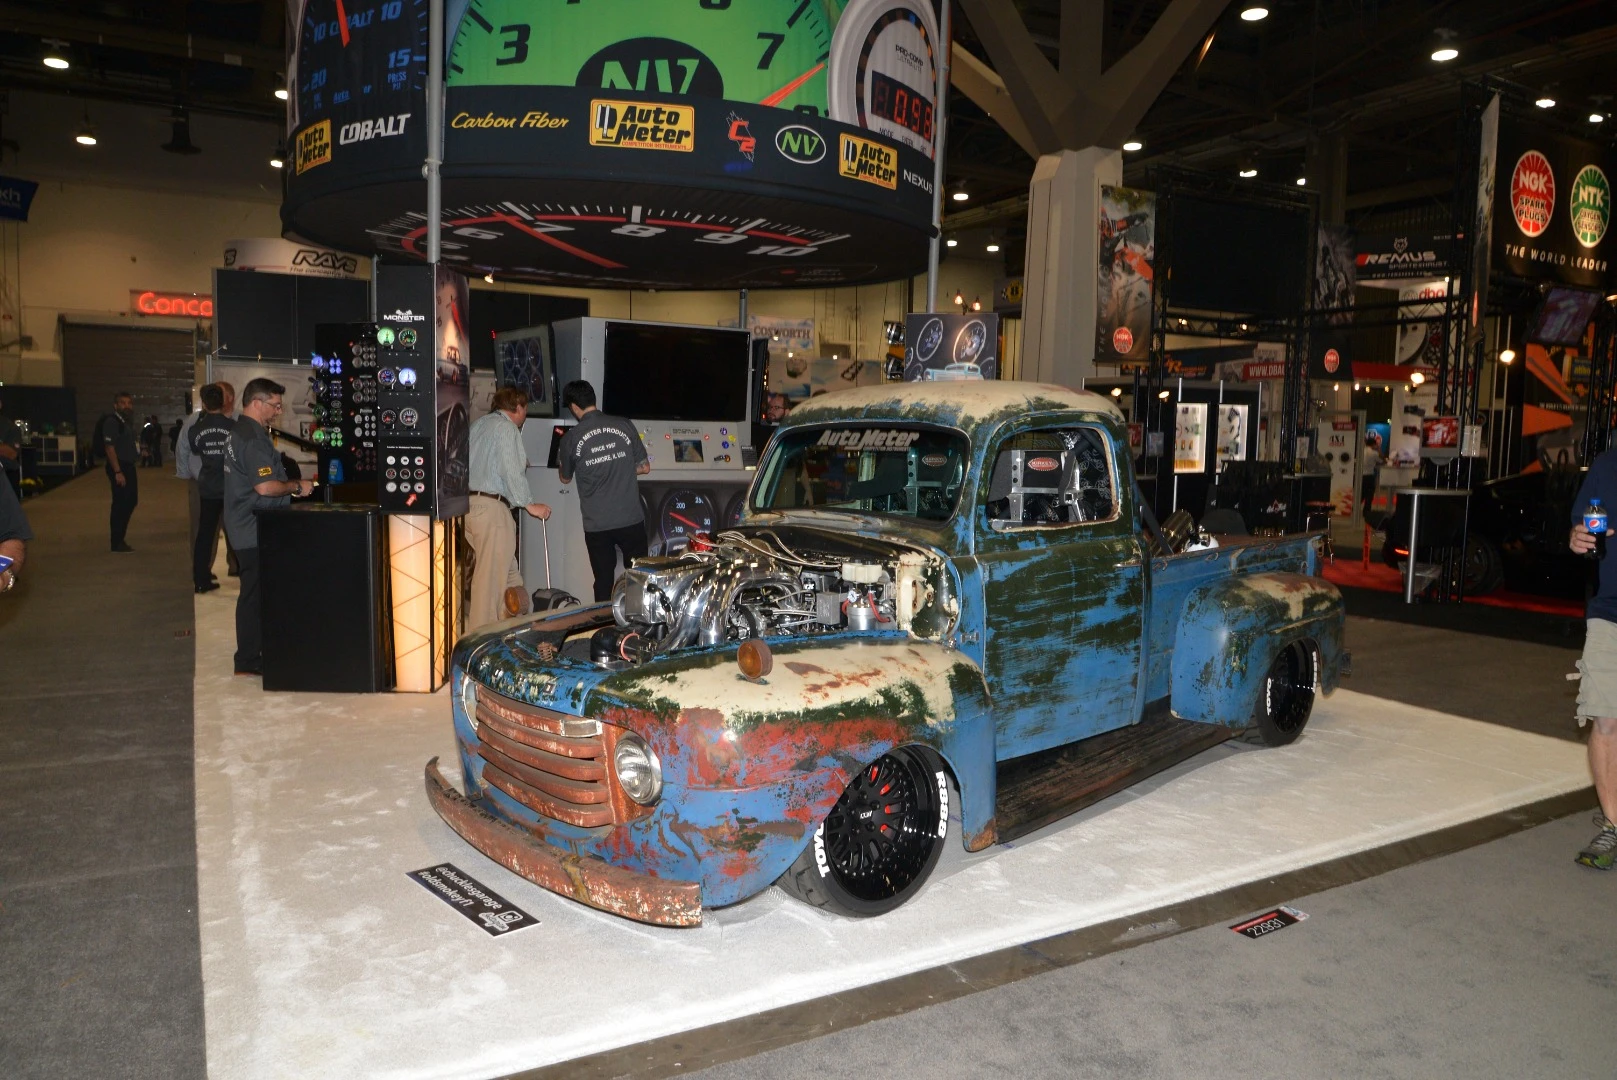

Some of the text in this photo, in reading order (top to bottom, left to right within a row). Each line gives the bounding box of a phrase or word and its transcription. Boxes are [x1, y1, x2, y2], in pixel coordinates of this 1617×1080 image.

[496, 23, 531, 66] 3
[756, 32, 786, 70] 7
[388, 48, 411, 69] 15
[451, 111, 569, 129] Carbon Fiber
[621, 105, 680, 125] Auto
[304, 127, 324, 144] Auto
[339, 113, 411, 146] COBALT
[619, 123, 691, 145] Meter
[302, 142, 330, 164] Meter
[860, 143, 891, 165] Auto
[857, 158, 895, 183] Meter
[903, 169, 933, 195] NEXUS
[1519, 170, 1548, 195] NGK
[1519, 195, 1546, 210] SPARK
[1579, 184, 1604, 208] NTK
[1519, 209, 1546, 223] PLUGS
[611, 224, 667, 238] 8
[693, 232, 749, 245] 9
[291, 249, 358, 275] RAYS
[747, 247, 818, 257] 10
[1365, 250, 1437, 265] REMUS
[1505, 243, 1608, 272] THE WORLD LEADER
[383, 314, 425, 322] MONSTER
[753, 325, 811, 339] COSWORTH
[575, 427, 632, 457] AUTO METER PRODUCTS
[817, 429, 920, 448] Auto Meter
[436, 866, 502, 910] @chucklesgarage
[1246, 918, 1286, 936] 22831
